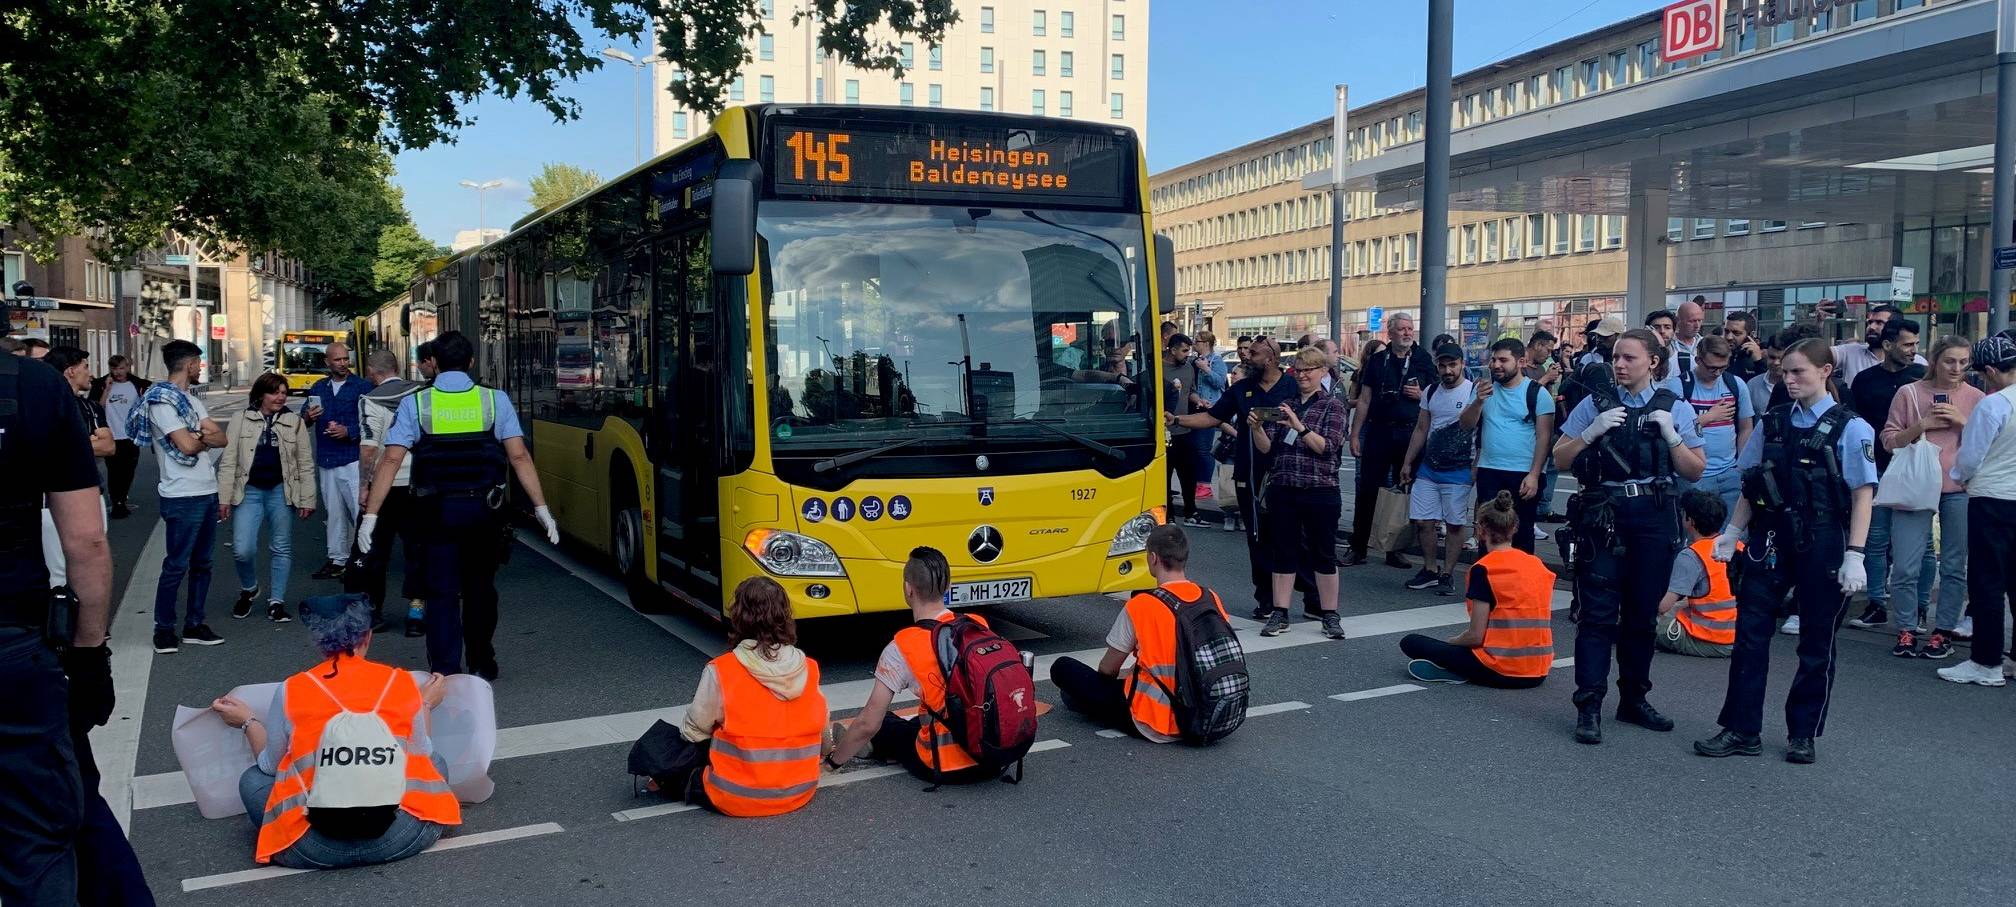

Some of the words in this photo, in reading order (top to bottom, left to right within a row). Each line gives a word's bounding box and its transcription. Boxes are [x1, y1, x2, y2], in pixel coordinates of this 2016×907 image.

[1670, 3, 1712, 51] DB
[786, 131, 850, 182] 145
[930, 139, 1049, 167] Heisingen
[910, 160, 1068, 190] Baldeneysee
[437, 408, 477, 421] POLIZEI
[1070, 488, 1096, 500] 1927
[1029, 527, 1069, 535] CITARO
[950, 586, 960, 602] E
[970, 583, 990, 600] MH
[993, 580, 1029, 598] 1927
[320, 746, 396, 767] HORST
